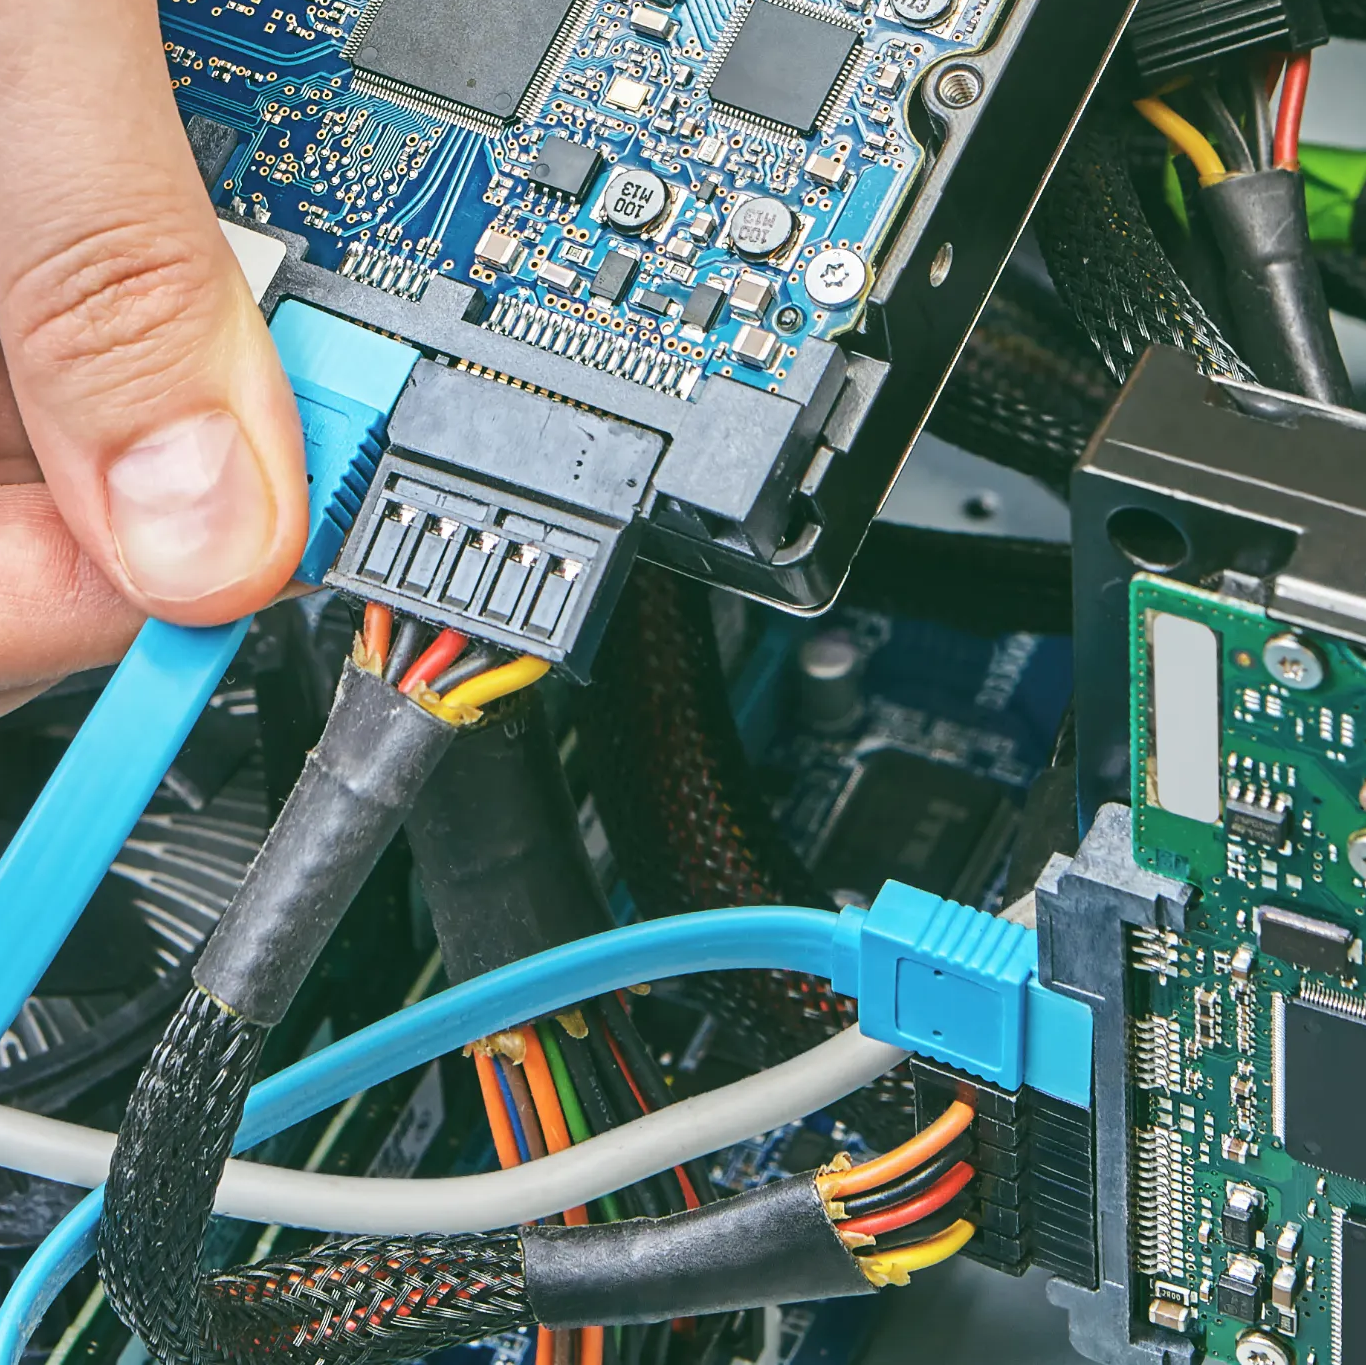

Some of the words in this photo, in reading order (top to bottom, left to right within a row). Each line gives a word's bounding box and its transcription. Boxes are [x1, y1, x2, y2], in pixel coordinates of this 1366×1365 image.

[621, 181, 654, 204] M13
[613, 197, 645, 219] 100
[744, 209, 777, 228] M13
[738, 225, 770, 244] 100
